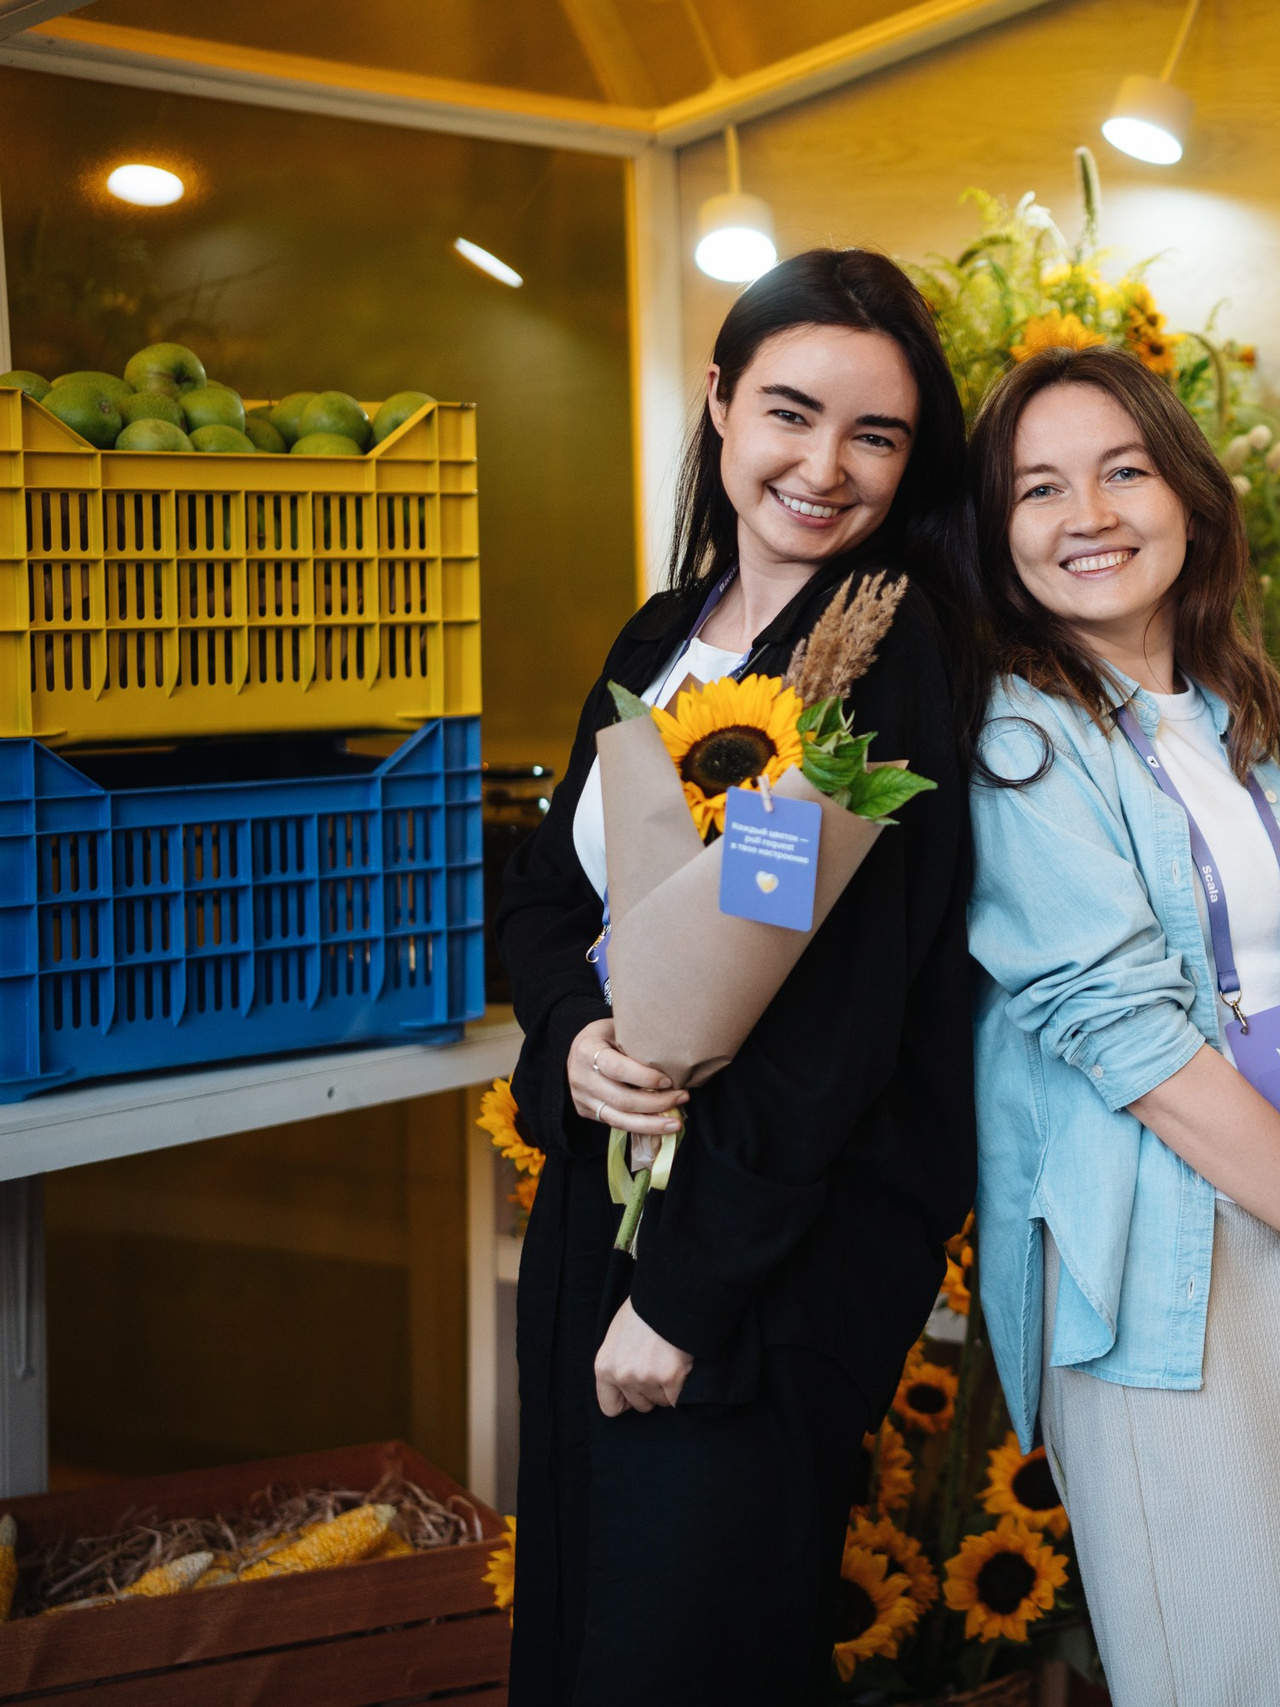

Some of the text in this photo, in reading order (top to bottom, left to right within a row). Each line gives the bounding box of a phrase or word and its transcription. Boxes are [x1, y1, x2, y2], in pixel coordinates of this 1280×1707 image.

[768, 830, 799, 842] цветок
[758, 848, 809, 864] настроение
[1202, 865, 1219, 903] Scala
